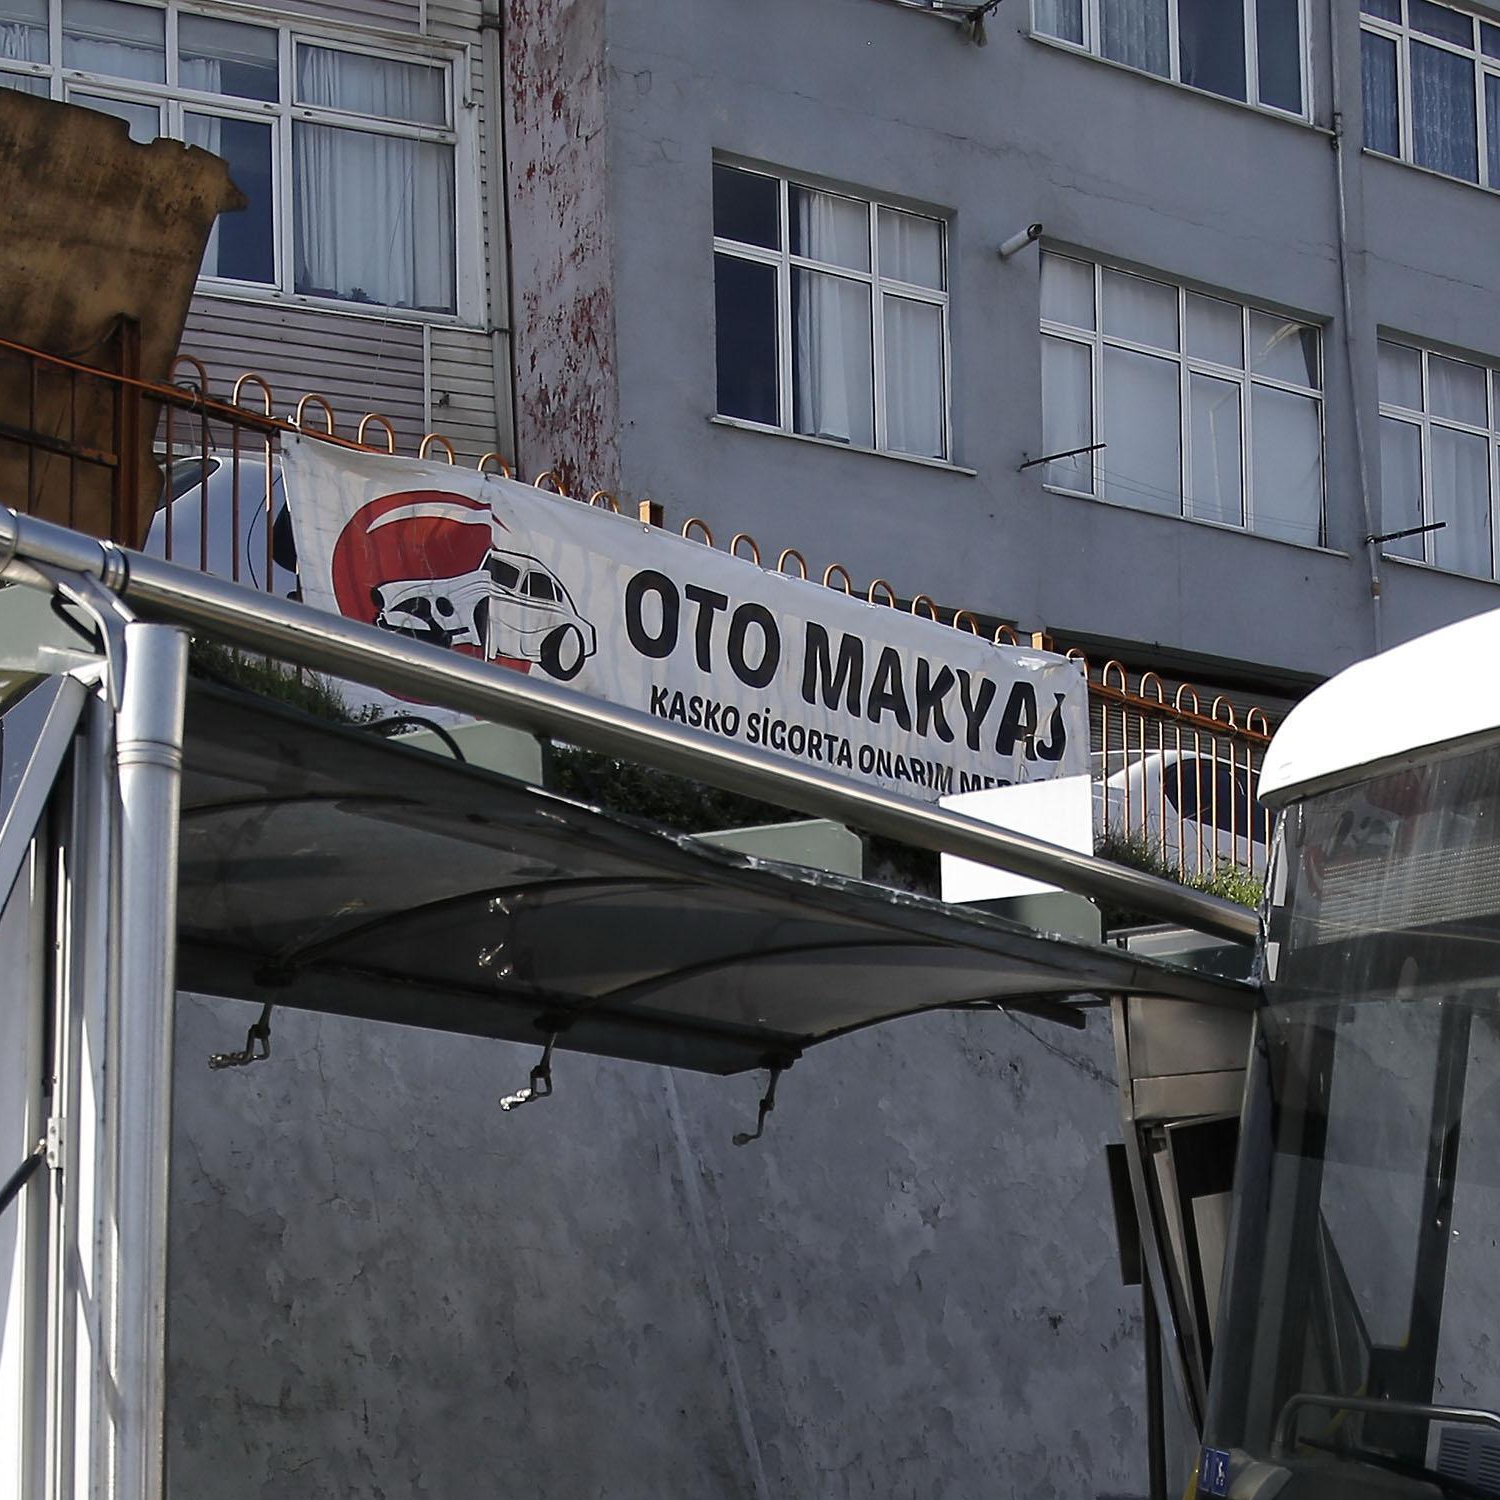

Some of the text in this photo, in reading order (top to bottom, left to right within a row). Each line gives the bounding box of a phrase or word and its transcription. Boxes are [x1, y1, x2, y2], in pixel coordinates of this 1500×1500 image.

[624, 569, 1066, 762] OTO MAKYAJ
[650, 685, 741, 737] KASKO
[746, 706, 853, 770] SİGORTA
[858, 743, 954, 795] ONARIM
